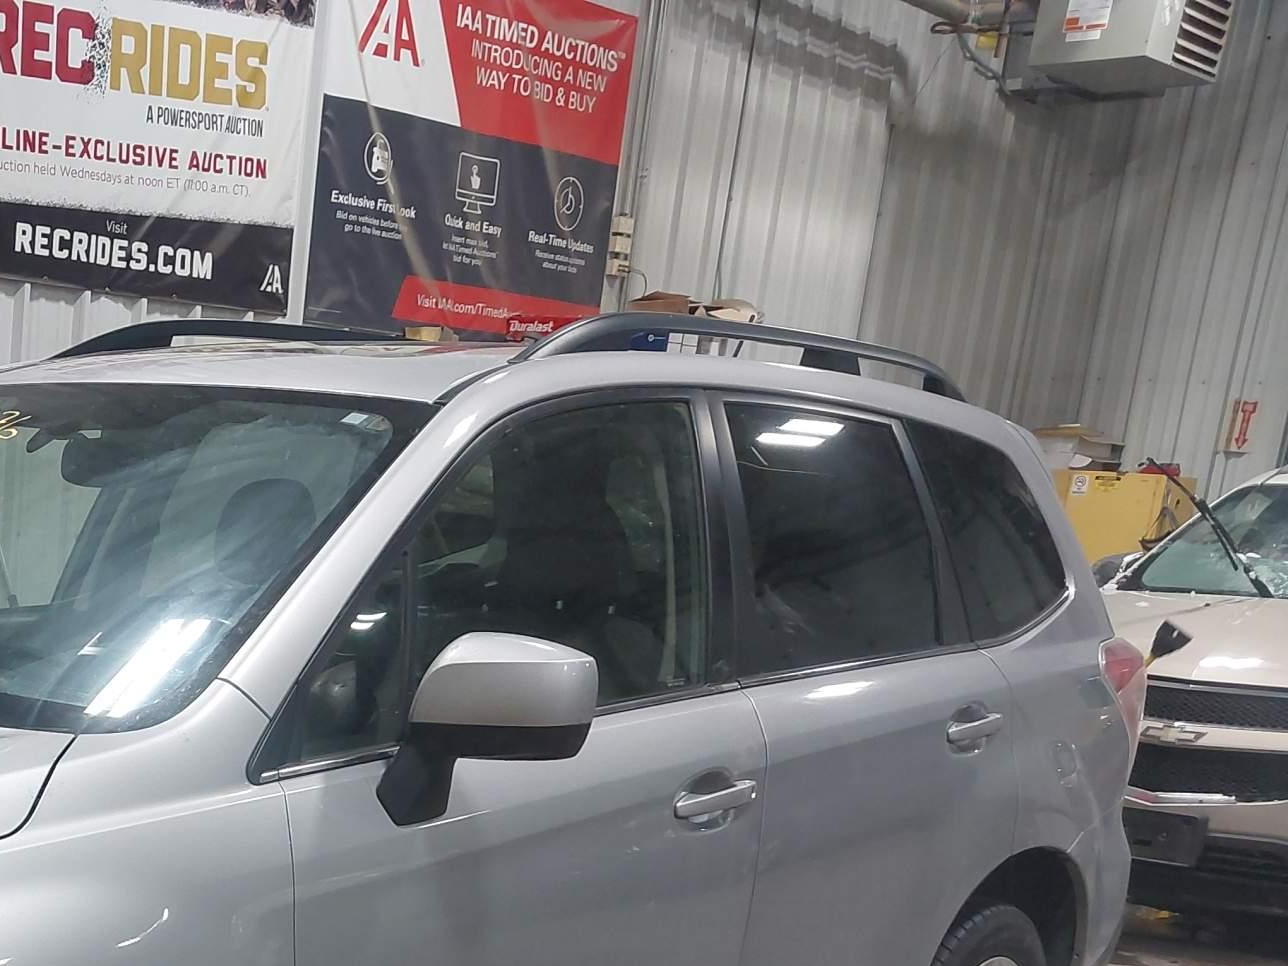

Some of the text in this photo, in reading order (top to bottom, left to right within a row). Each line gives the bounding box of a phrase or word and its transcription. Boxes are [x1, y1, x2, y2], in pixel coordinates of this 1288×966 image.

[456, 3, 482, 34] IAA
[485, 13, 539, 49] TIMED
[472, 38, 607, 93] INTRODUCING A NEW
[476, 65, 597, 113] WAY TO BID & BUY
[146, 105, 264, 138] A POWERSPORT AUCTION
[33, 160, 56, 176] held
[60, 166, 122, 185] Wednesdays
[124, 173, 134, 185] at
[137, 176, 163, 188] noon
[167, 177, 181, 189] ET
[188, 150, 268, 179] AUCTION
[330, 189, 375, 210] Exclusive
[105, 219, 128, 236] Visit
[444, 213, 502, 238] Quick and Easy
[528, 230, 567, 249] Real-Time
[14, 222, 213, 280] RECRIDES.COM
[417, 293, 436, 308] Visit
[509, 320, 554, 333] Duralast
